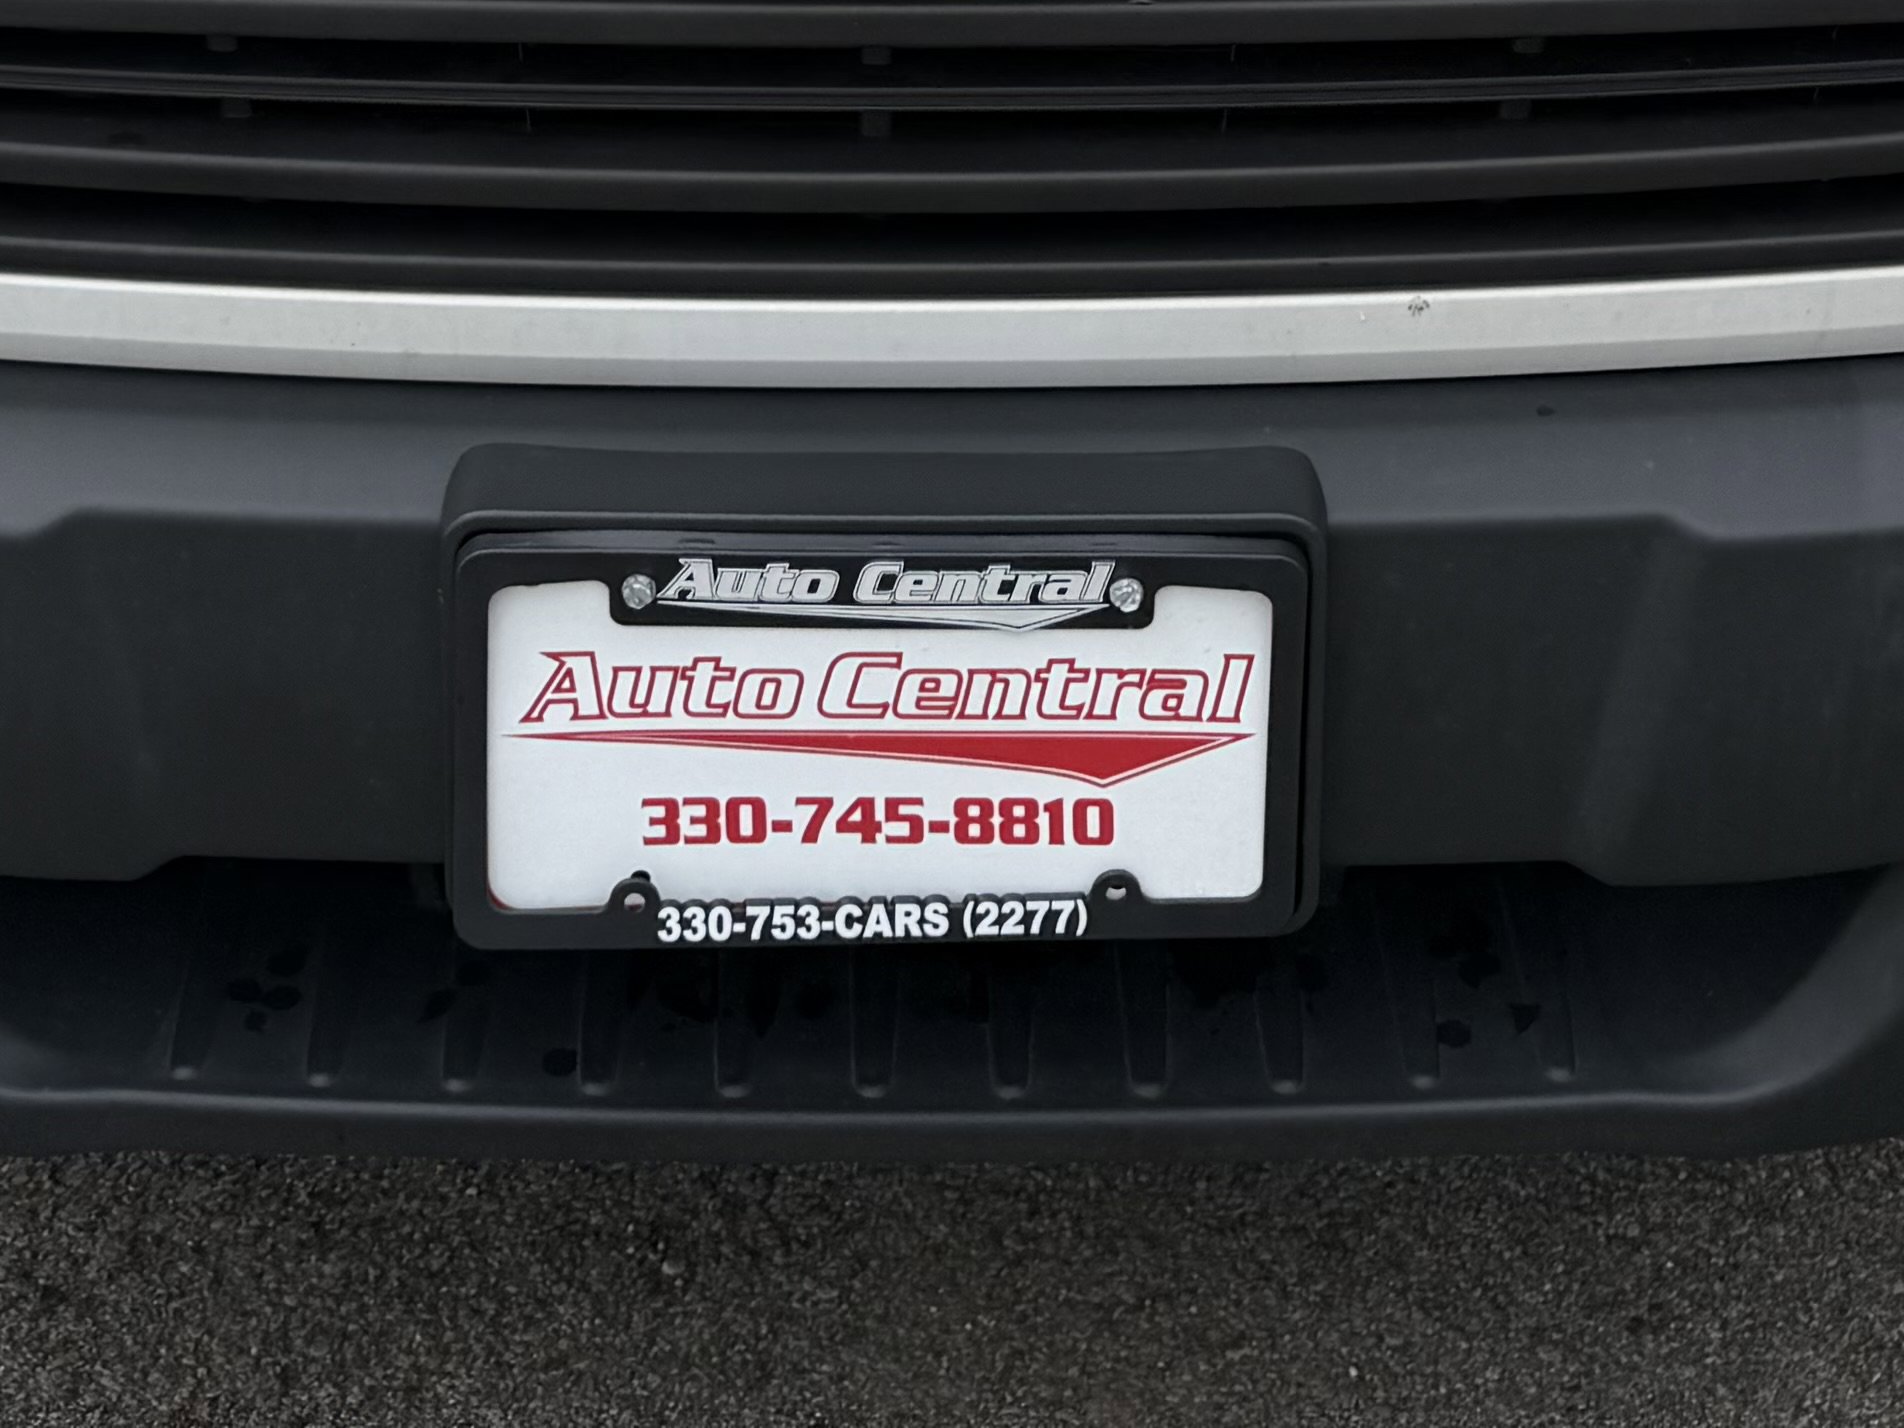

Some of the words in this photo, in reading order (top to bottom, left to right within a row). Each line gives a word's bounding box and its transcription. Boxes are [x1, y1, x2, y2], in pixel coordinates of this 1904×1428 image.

[657, 558, 841, 604] Auto
[853, 560, 1117, 606] Central
[518, 651, 805, 724] Auto
[817, 651, 1257, 724] Central
[640, 796, 1116, 847] 330-745-8810
[656, 902, 951, 943] 330-753-CARS
[962, 897, 1090, 939] (2277)
